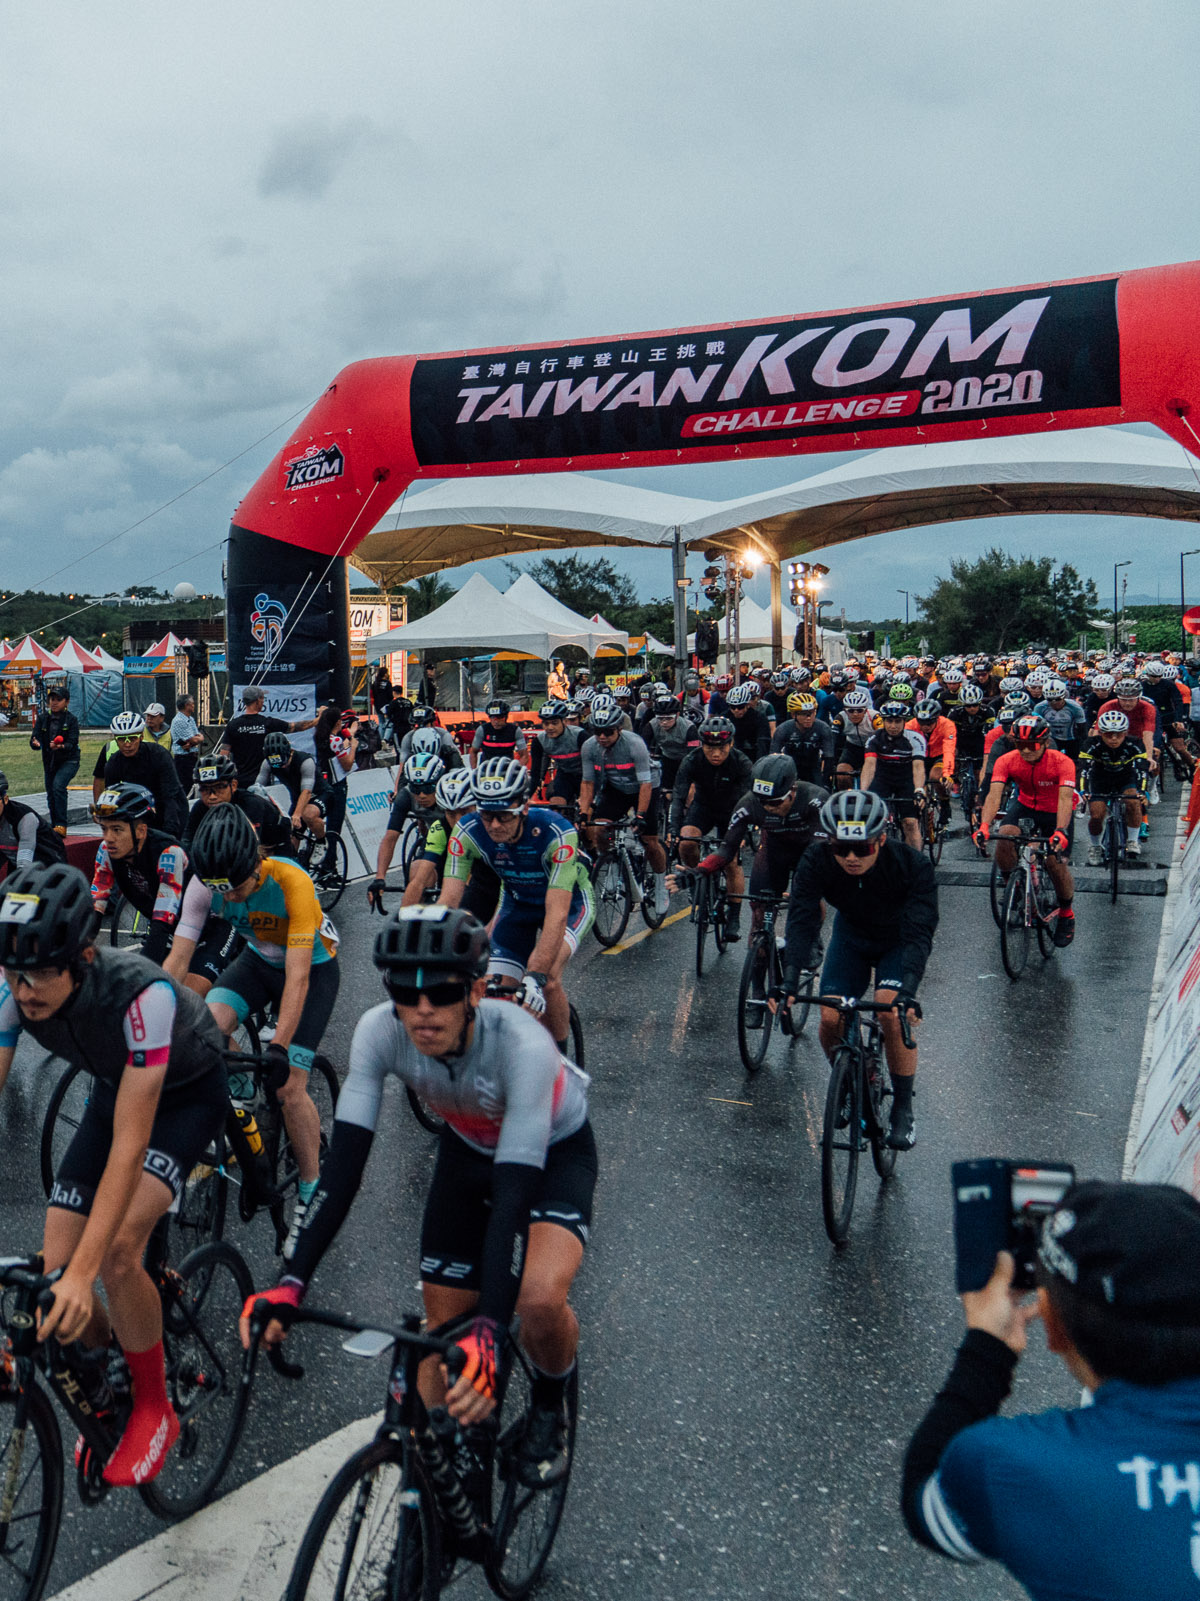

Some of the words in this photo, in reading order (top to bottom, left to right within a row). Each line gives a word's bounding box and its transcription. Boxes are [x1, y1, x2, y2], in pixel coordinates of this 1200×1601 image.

[455, 363, 723, 424] TAIWAN
[717, 295, 1051, 402] KOM
[462, 341, 726, 380] 臺灣自行車登山王挑戰
[692, 394, 908, 434] CHALLENGE
[921, 369, 1044, 415] 2020
[296, 456, 326, 468] TAIWAN
[290, 458, 340, 485] KOM
[291, 476, 336, 491] CHALLENGE
[202, 769, 216, 778] 24
[483, 781, 502, 791] 60
[756, 783, 770, 793] 16
[841, 826, 863, 836] 14
[9, 901, 27, 917] 7
